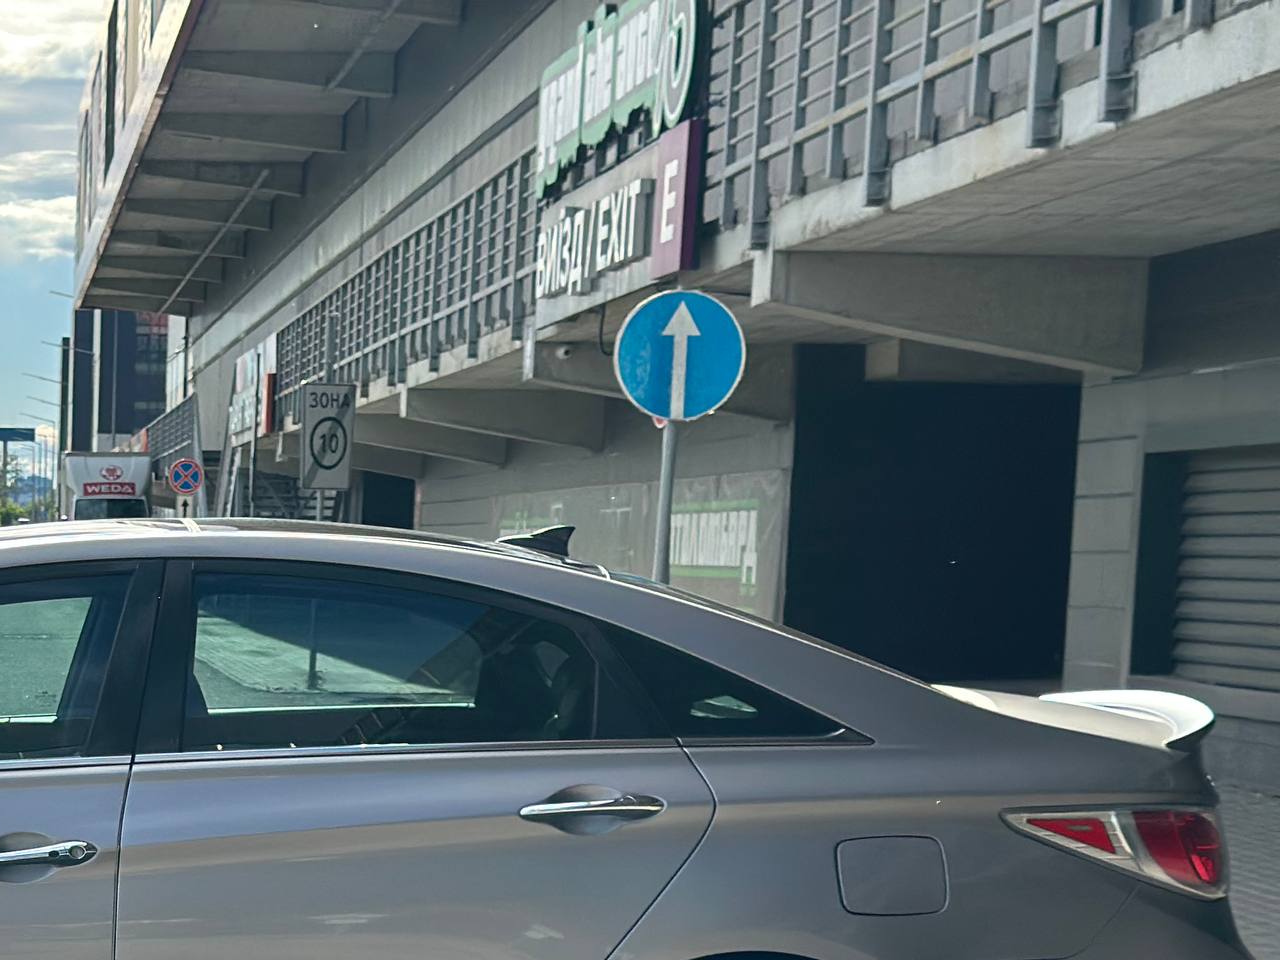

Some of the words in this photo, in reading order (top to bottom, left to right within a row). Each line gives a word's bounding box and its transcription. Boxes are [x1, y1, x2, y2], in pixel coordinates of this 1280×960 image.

[596, 179, 641, 272] EXIT
[309, 392, 351, 409] ЗОНА
[320, 433, 339, 454] 10
[86, 484, 134, 494] WEDA
